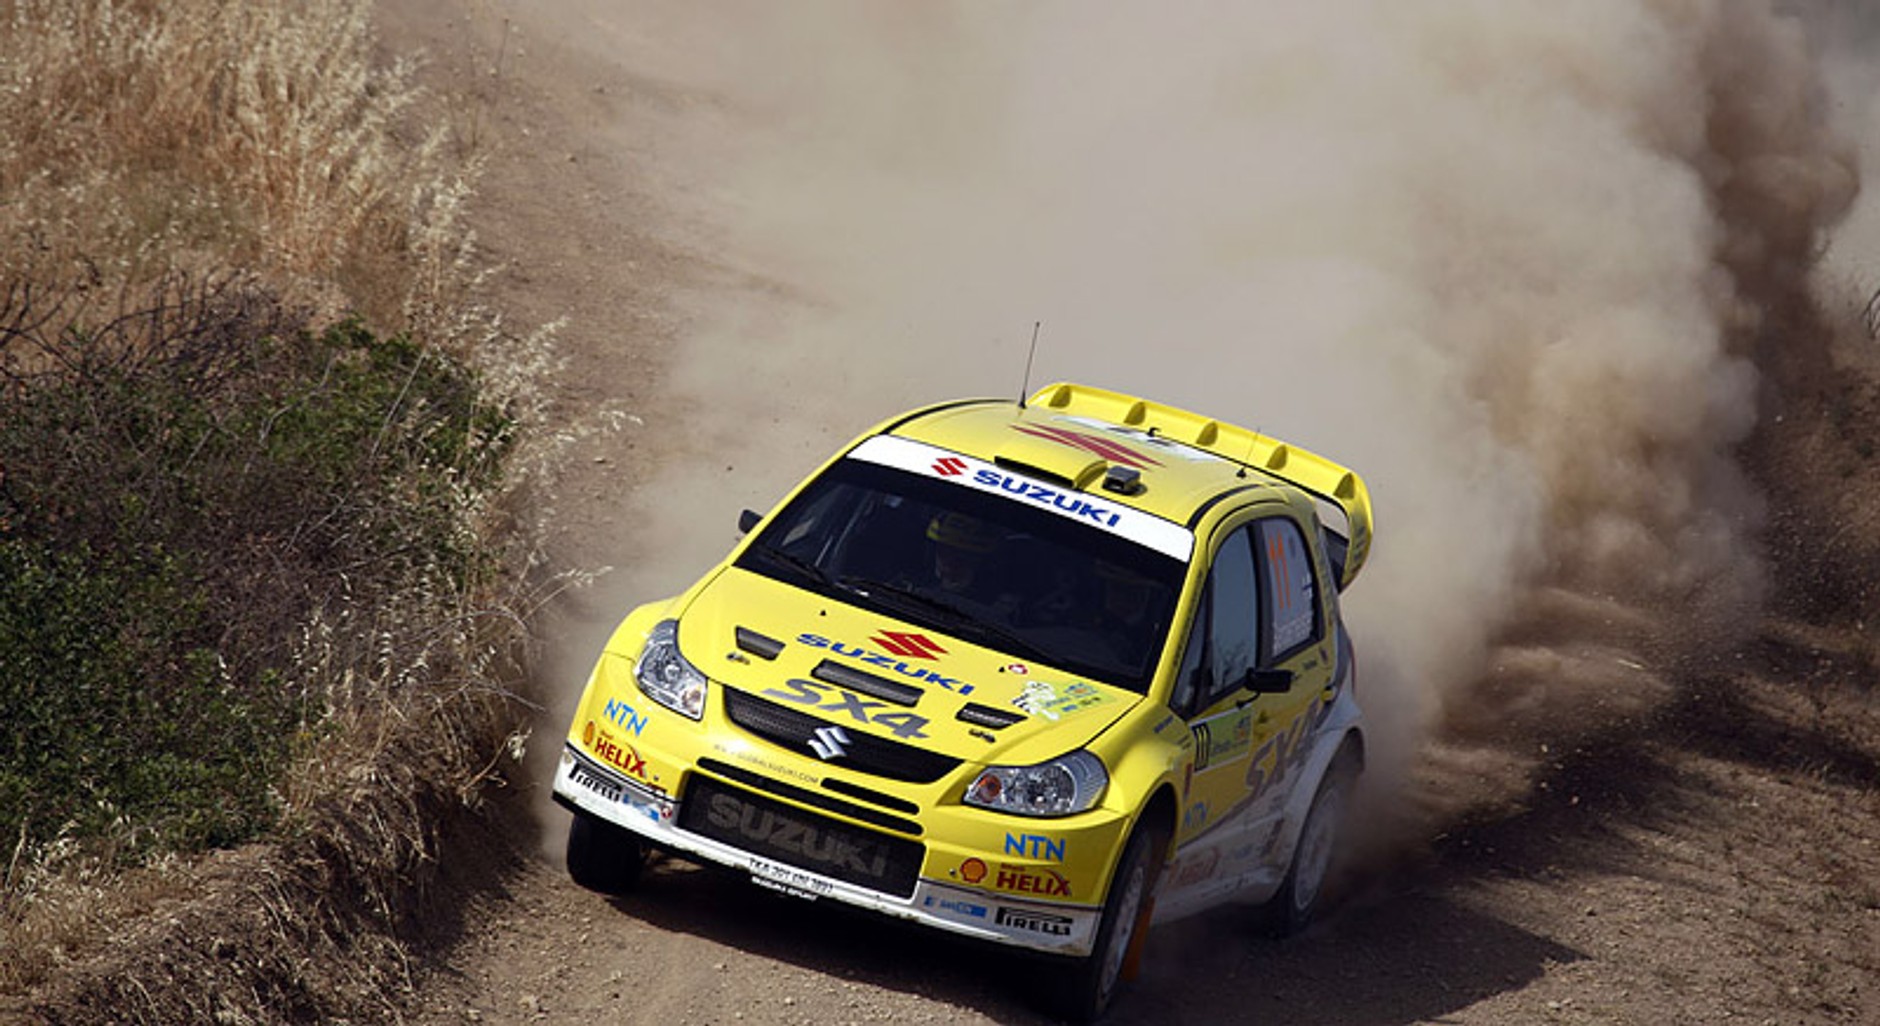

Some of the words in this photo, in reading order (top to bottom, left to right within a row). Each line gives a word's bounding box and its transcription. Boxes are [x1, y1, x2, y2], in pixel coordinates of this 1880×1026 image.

[972, 468, 1122, 529] SUZUKI
[797, 633, 976, 696] SUZUKI
[602, 698, 649, 736] NTN
[761, 678, 931, 740] SX4
[594, 737, 647, 778] HELIX
[707, 793, 890, 878] SUZUKI
[1004, 831, 1067, 863] NTN
[996, 868, 1073, 897] HELIX
[994, 906, 1075, 936] PIRELLI
